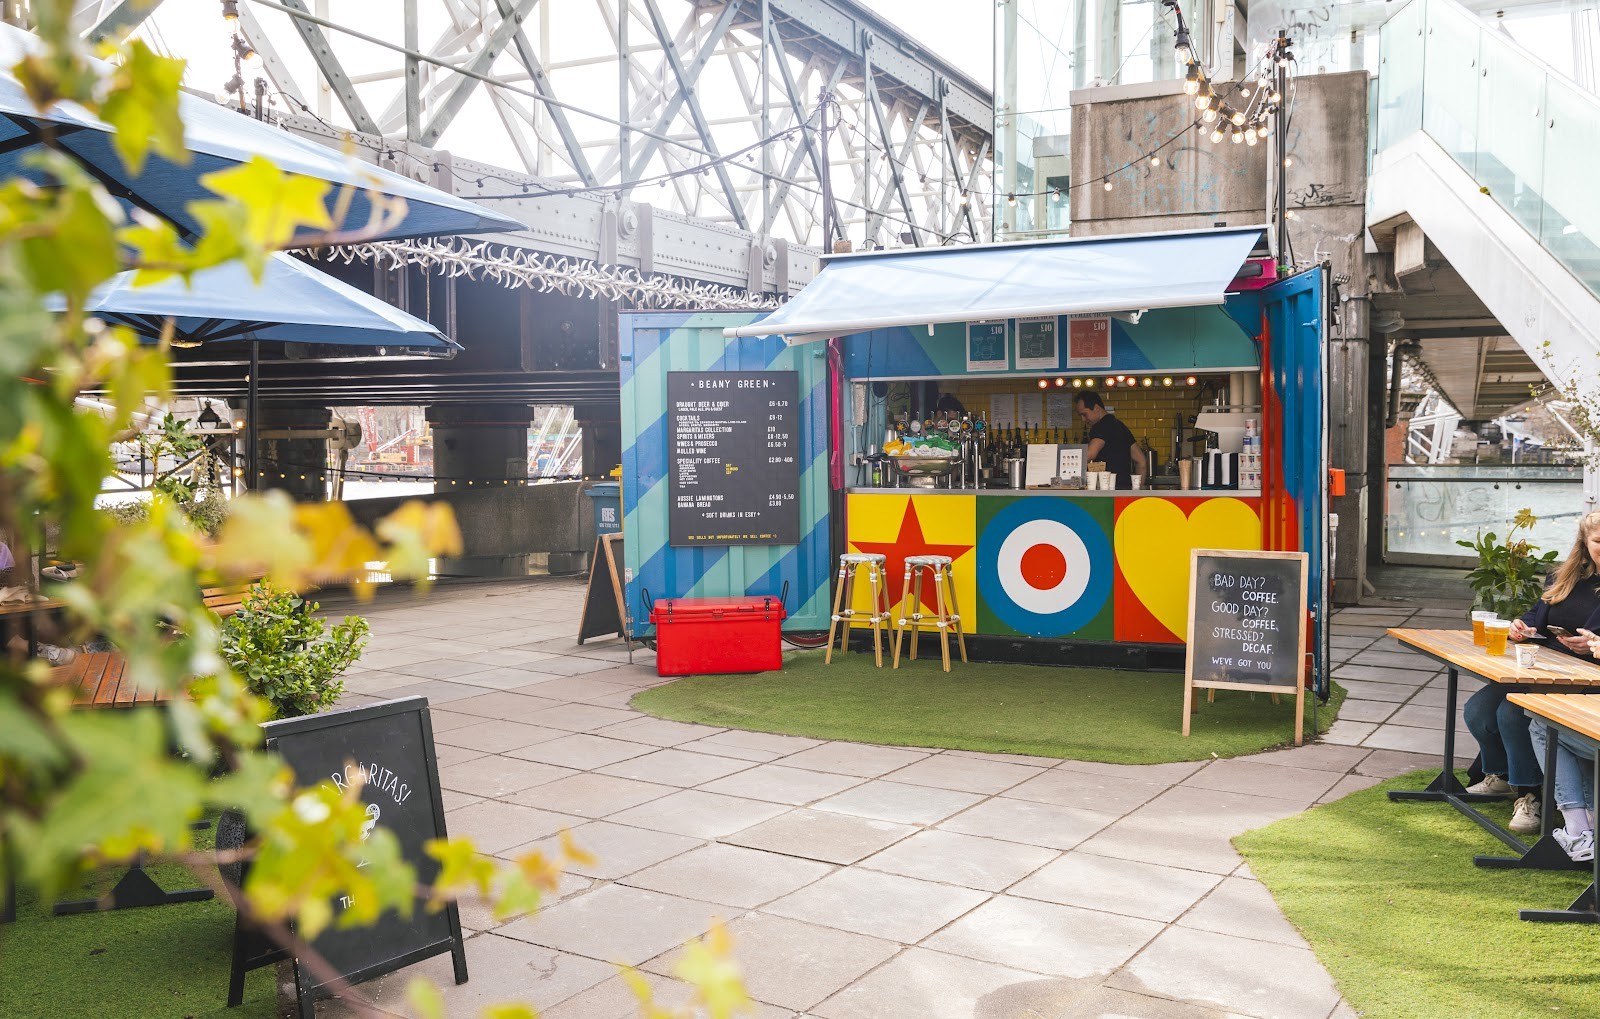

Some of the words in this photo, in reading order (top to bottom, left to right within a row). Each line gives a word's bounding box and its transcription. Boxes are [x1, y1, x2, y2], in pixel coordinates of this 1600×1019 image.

[991, 326, 1003, 335] £10
[1040, 323, 1053, 332] £10
[698, 379, 731, 389] BEANY
[737, 379, 770, 389] GREEN
[676, 447, 695, 455] MULLED
[705, 511, 718, 519] SOFT
[1214, 573, 1235, 588] BAD
[1239, 575, 1267, 590] DAY?
[1242, 590, 1279, 604] COFFEE.
[1211, 600, 1240, 614] GOOD
[1243, 604, 1270, 618] DAY?
[1212, 626, 1265, 642] STRESSED?
[1242, 642, 1274, 655] DECAF.
[1211, 656, 1233, 666] WE'VE
[1237, 658, 1253, 667] GOT
[1256, 661, 1271, 669] YOU
[321, 761, 412, 806] ARGARITAS!
